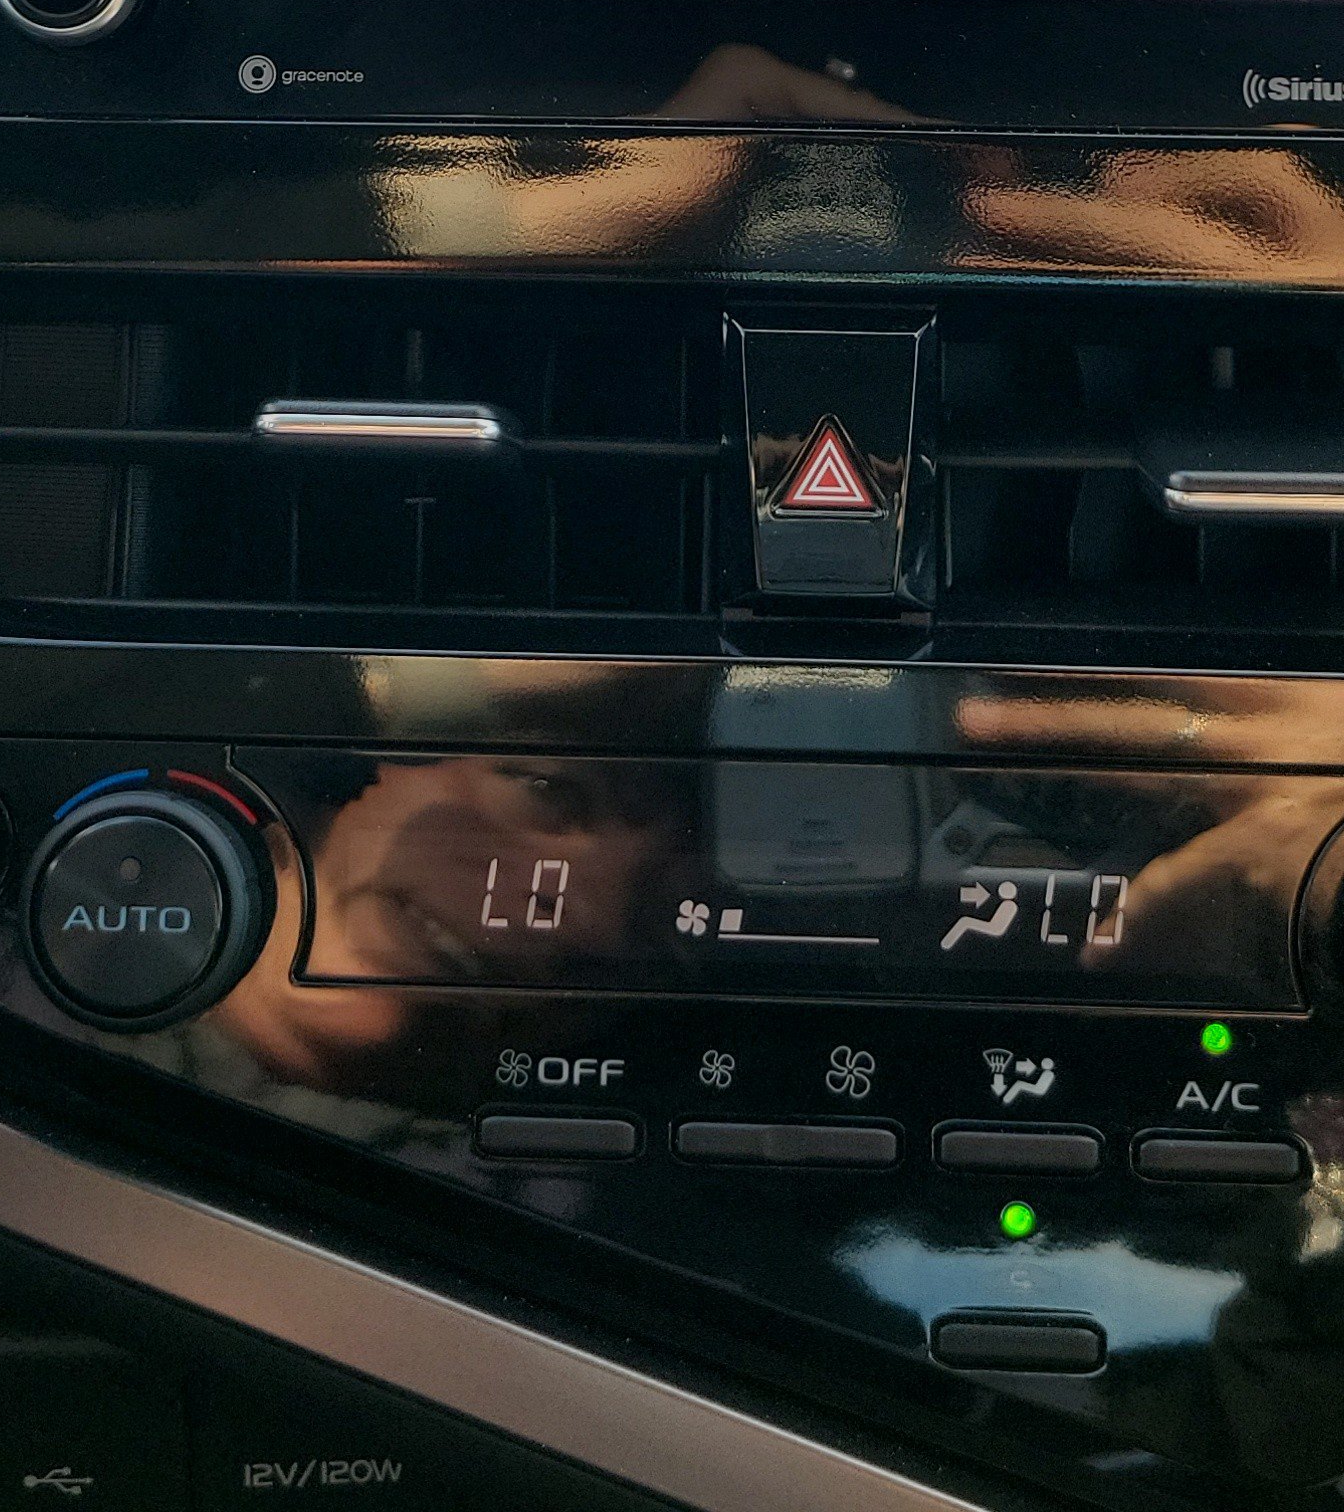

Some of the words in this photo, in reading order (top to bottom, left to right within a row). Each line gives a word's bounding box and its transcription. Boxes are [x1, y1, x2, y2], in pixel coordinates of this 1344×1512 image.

[282, 70, 364, 85] gracenote
[62, 905, 192, 934] AUTO
[536, 1056, 625, 1088] OFF
[1176, 1081, 1260, 1112] A/C
[243, 1459, 402, 1488] 12V/120W
